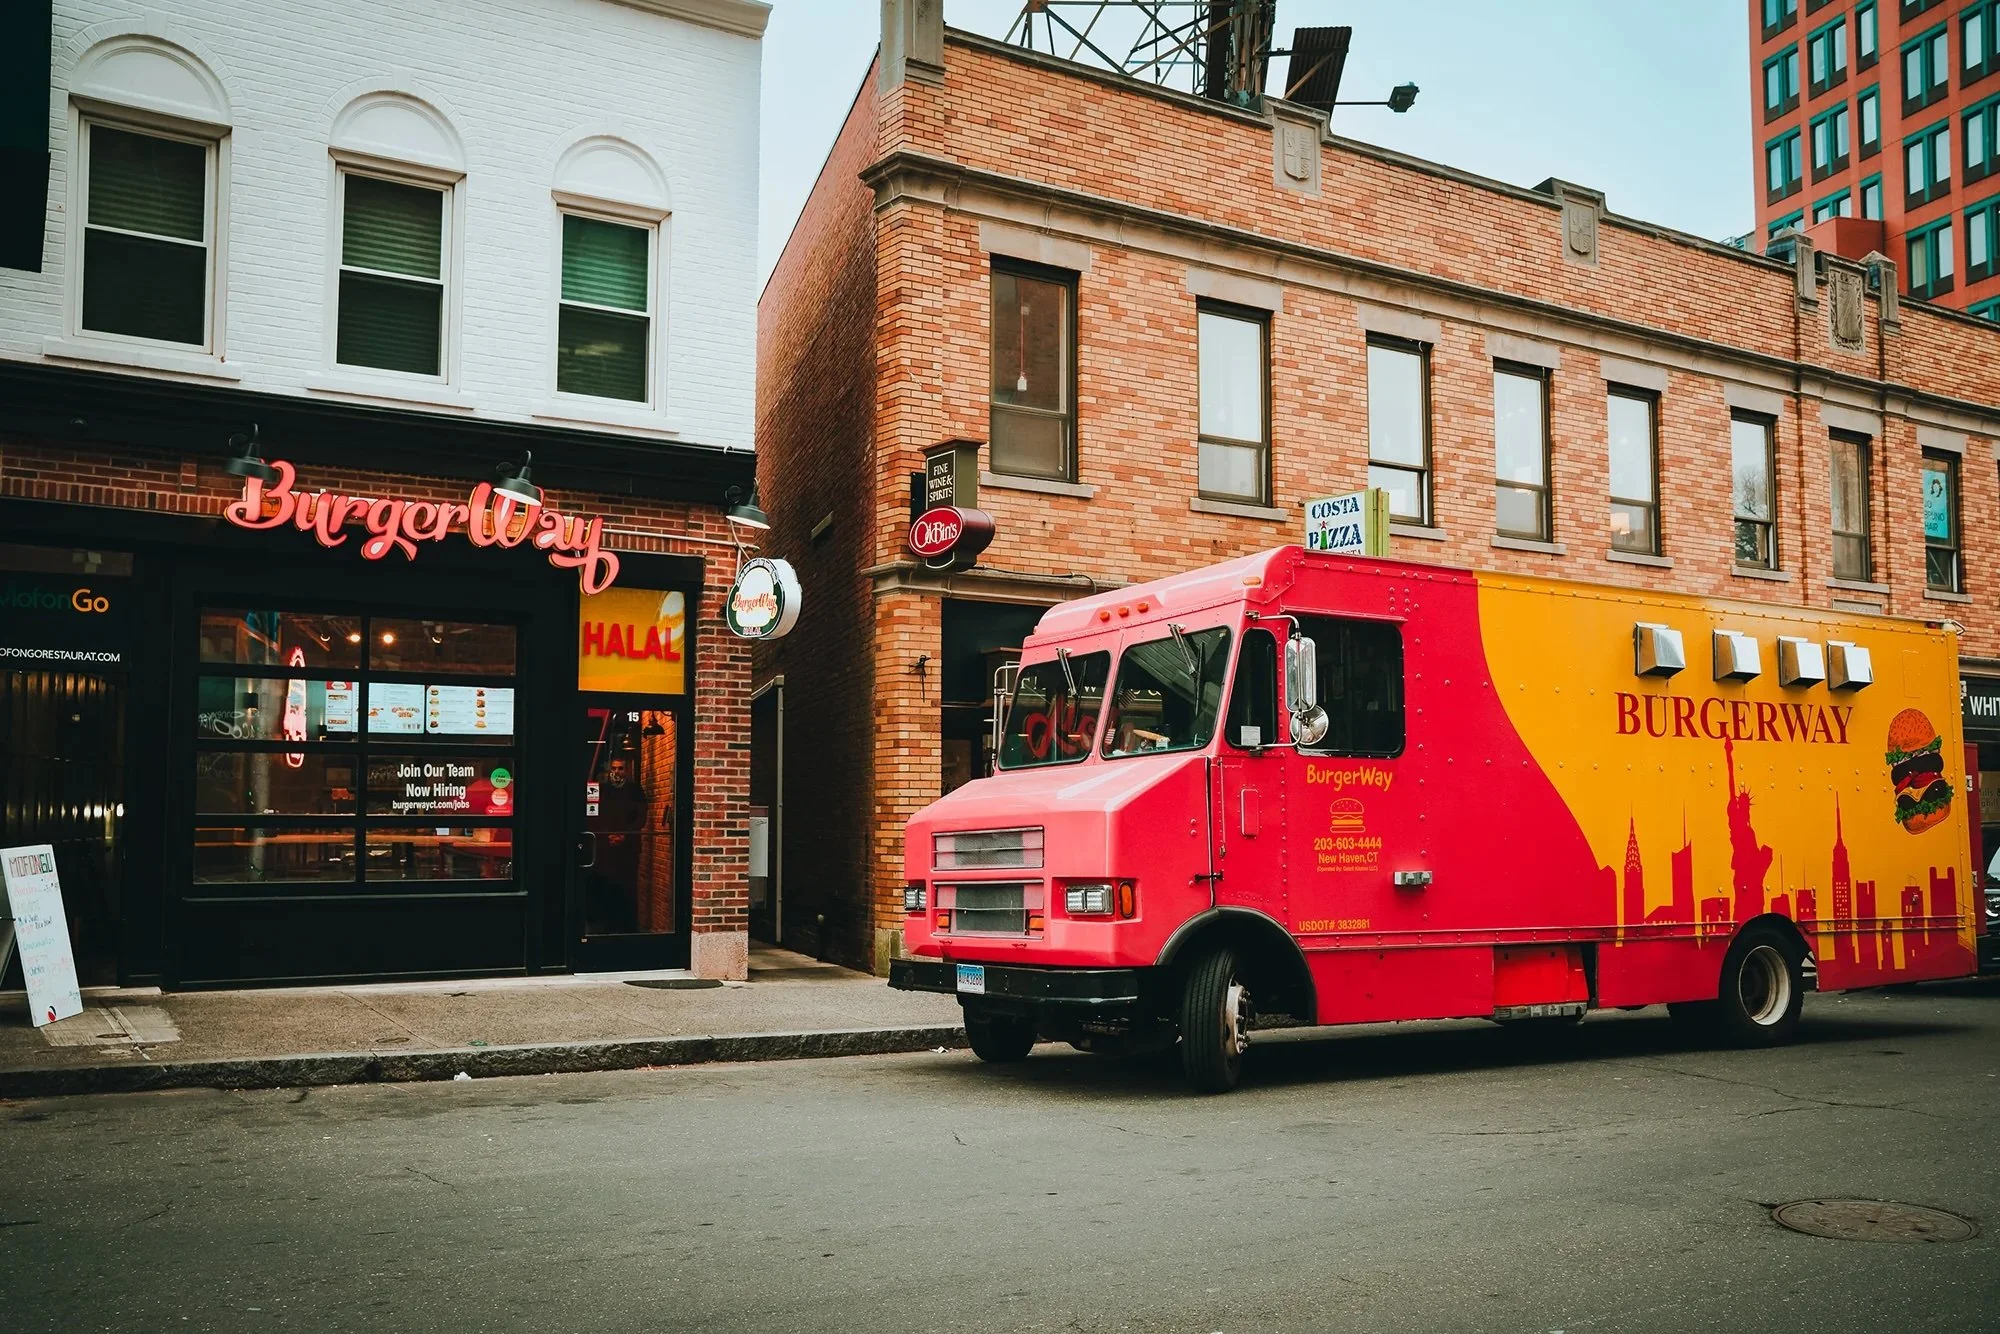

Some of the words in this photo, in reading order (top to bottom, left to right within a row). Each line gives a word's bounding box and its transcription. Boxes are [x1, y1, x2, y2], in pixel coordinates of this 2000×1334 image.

[933, 462, 949, 476] FINE
[929, 487, 953, 502] SPIRITS
[1312, 497, 1359, 519] COSTA
[224, 460, 620, 596] BurgerWay
[583, 621, 681, 662] HALAL
[627, 711, 640, 722] 15
[1614, 691, 1854, 744] BURGERWAY
[397, 763, 421, 778] Join
[424, 763, 445, 777] Our
[446, 763, 475, 777] Team
[1306, 764, 1393, 792] BurgerWay
[406, 783, 431, 798] Now
[433, 783, 467, 799] Hiring
[392, 799, 470, 811] burgerwayct.com/jobs
[1314, 837, 1382, 851] 203-603-4444
[9, 853, 53, 878] MOFONGO
[1318, 852, 1337, 865] New
[1298, 919, 1336, 931] USDOT#
[1337, 918, 1370, 930] 3832881
